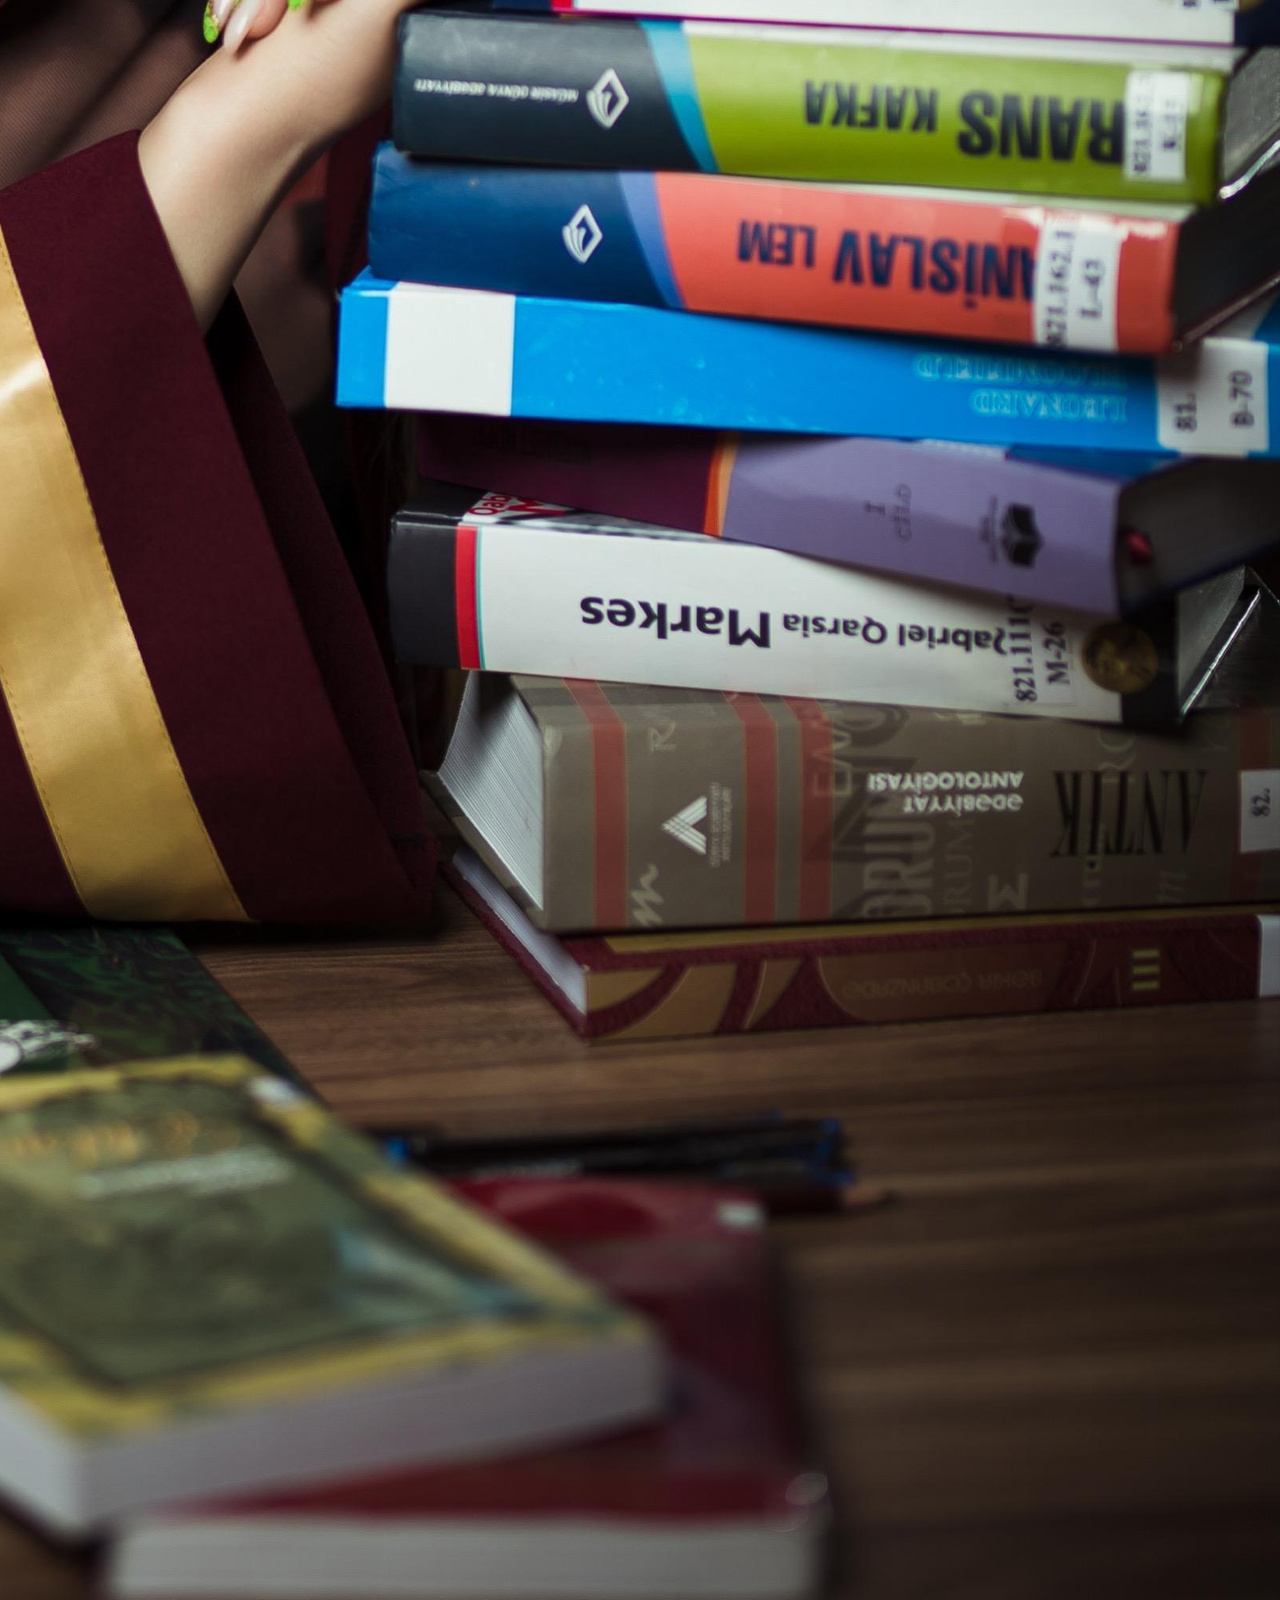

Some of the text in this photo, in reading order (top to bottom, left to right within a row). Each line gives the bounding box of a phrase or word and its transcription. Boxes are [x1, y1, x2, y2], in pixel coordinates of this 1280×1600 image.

[802, 79, 1126, 167] RANS KAFKA
[736, 218, 1035, 312] ANİSLAV LEM
[970, 388, 1128, 422] LEONARD
[578, 595, 772, 649] Markes
[781, 613, 889, 646] Qarsia
[1042, 621, 1070, 686] M-26
[865, 770, 1025, 796] ANTOLOGİYASI
[902, 792, 1025, 817] ƏDƏBİYYAT
[1051, 769, 1210, 867] ANTİK
